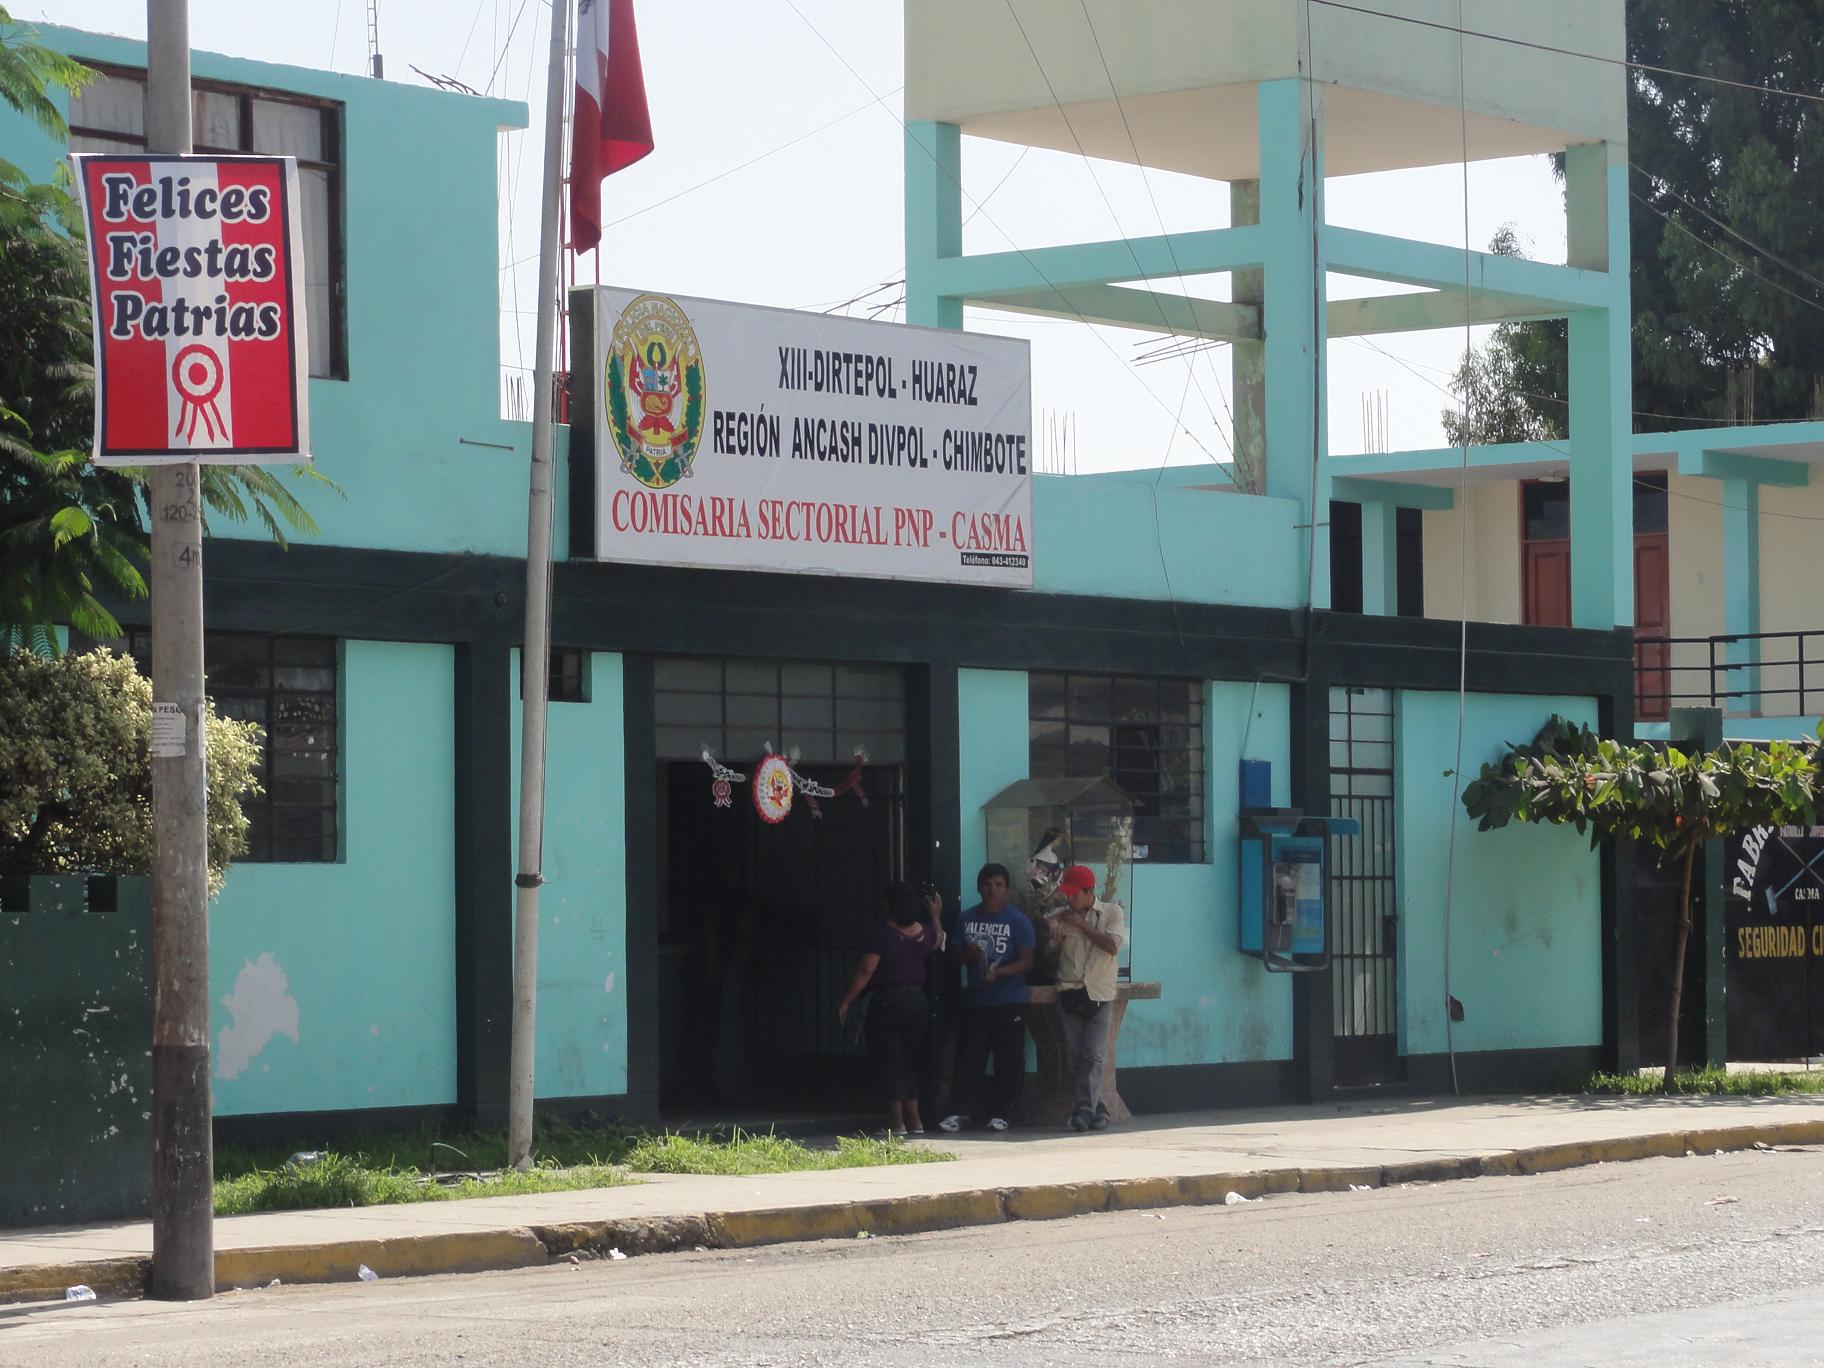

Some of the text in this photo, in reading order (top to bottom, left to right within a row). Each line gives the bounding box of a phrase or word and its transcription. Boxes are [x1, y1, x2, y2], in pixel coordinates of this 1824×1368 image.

[104, 174, 269, 222] Felices
[107, 231, 275, 281] Fiestas
[111, 291, 280, 340] Patrias
[911, 359, 978, 406] HUARAZ
[645, 445, 667, 456] PATRIA
[713, 403, 781, 458] REGIÓN
[791, 416, 863, 464] ANCASH
[868, 422, 928, 469] DIVPOL
[942, 428, 1027, 475] CHIMBOTE
[611, 489, 752, 539] COMISARIA
[757, 498, 888, 546] SECTORIAL
[893, 507, 933, 548] PNP
[951, 510, 1027, 553] CASMA
[1738, 924, 1824, 958] SEGURIDAD CI
